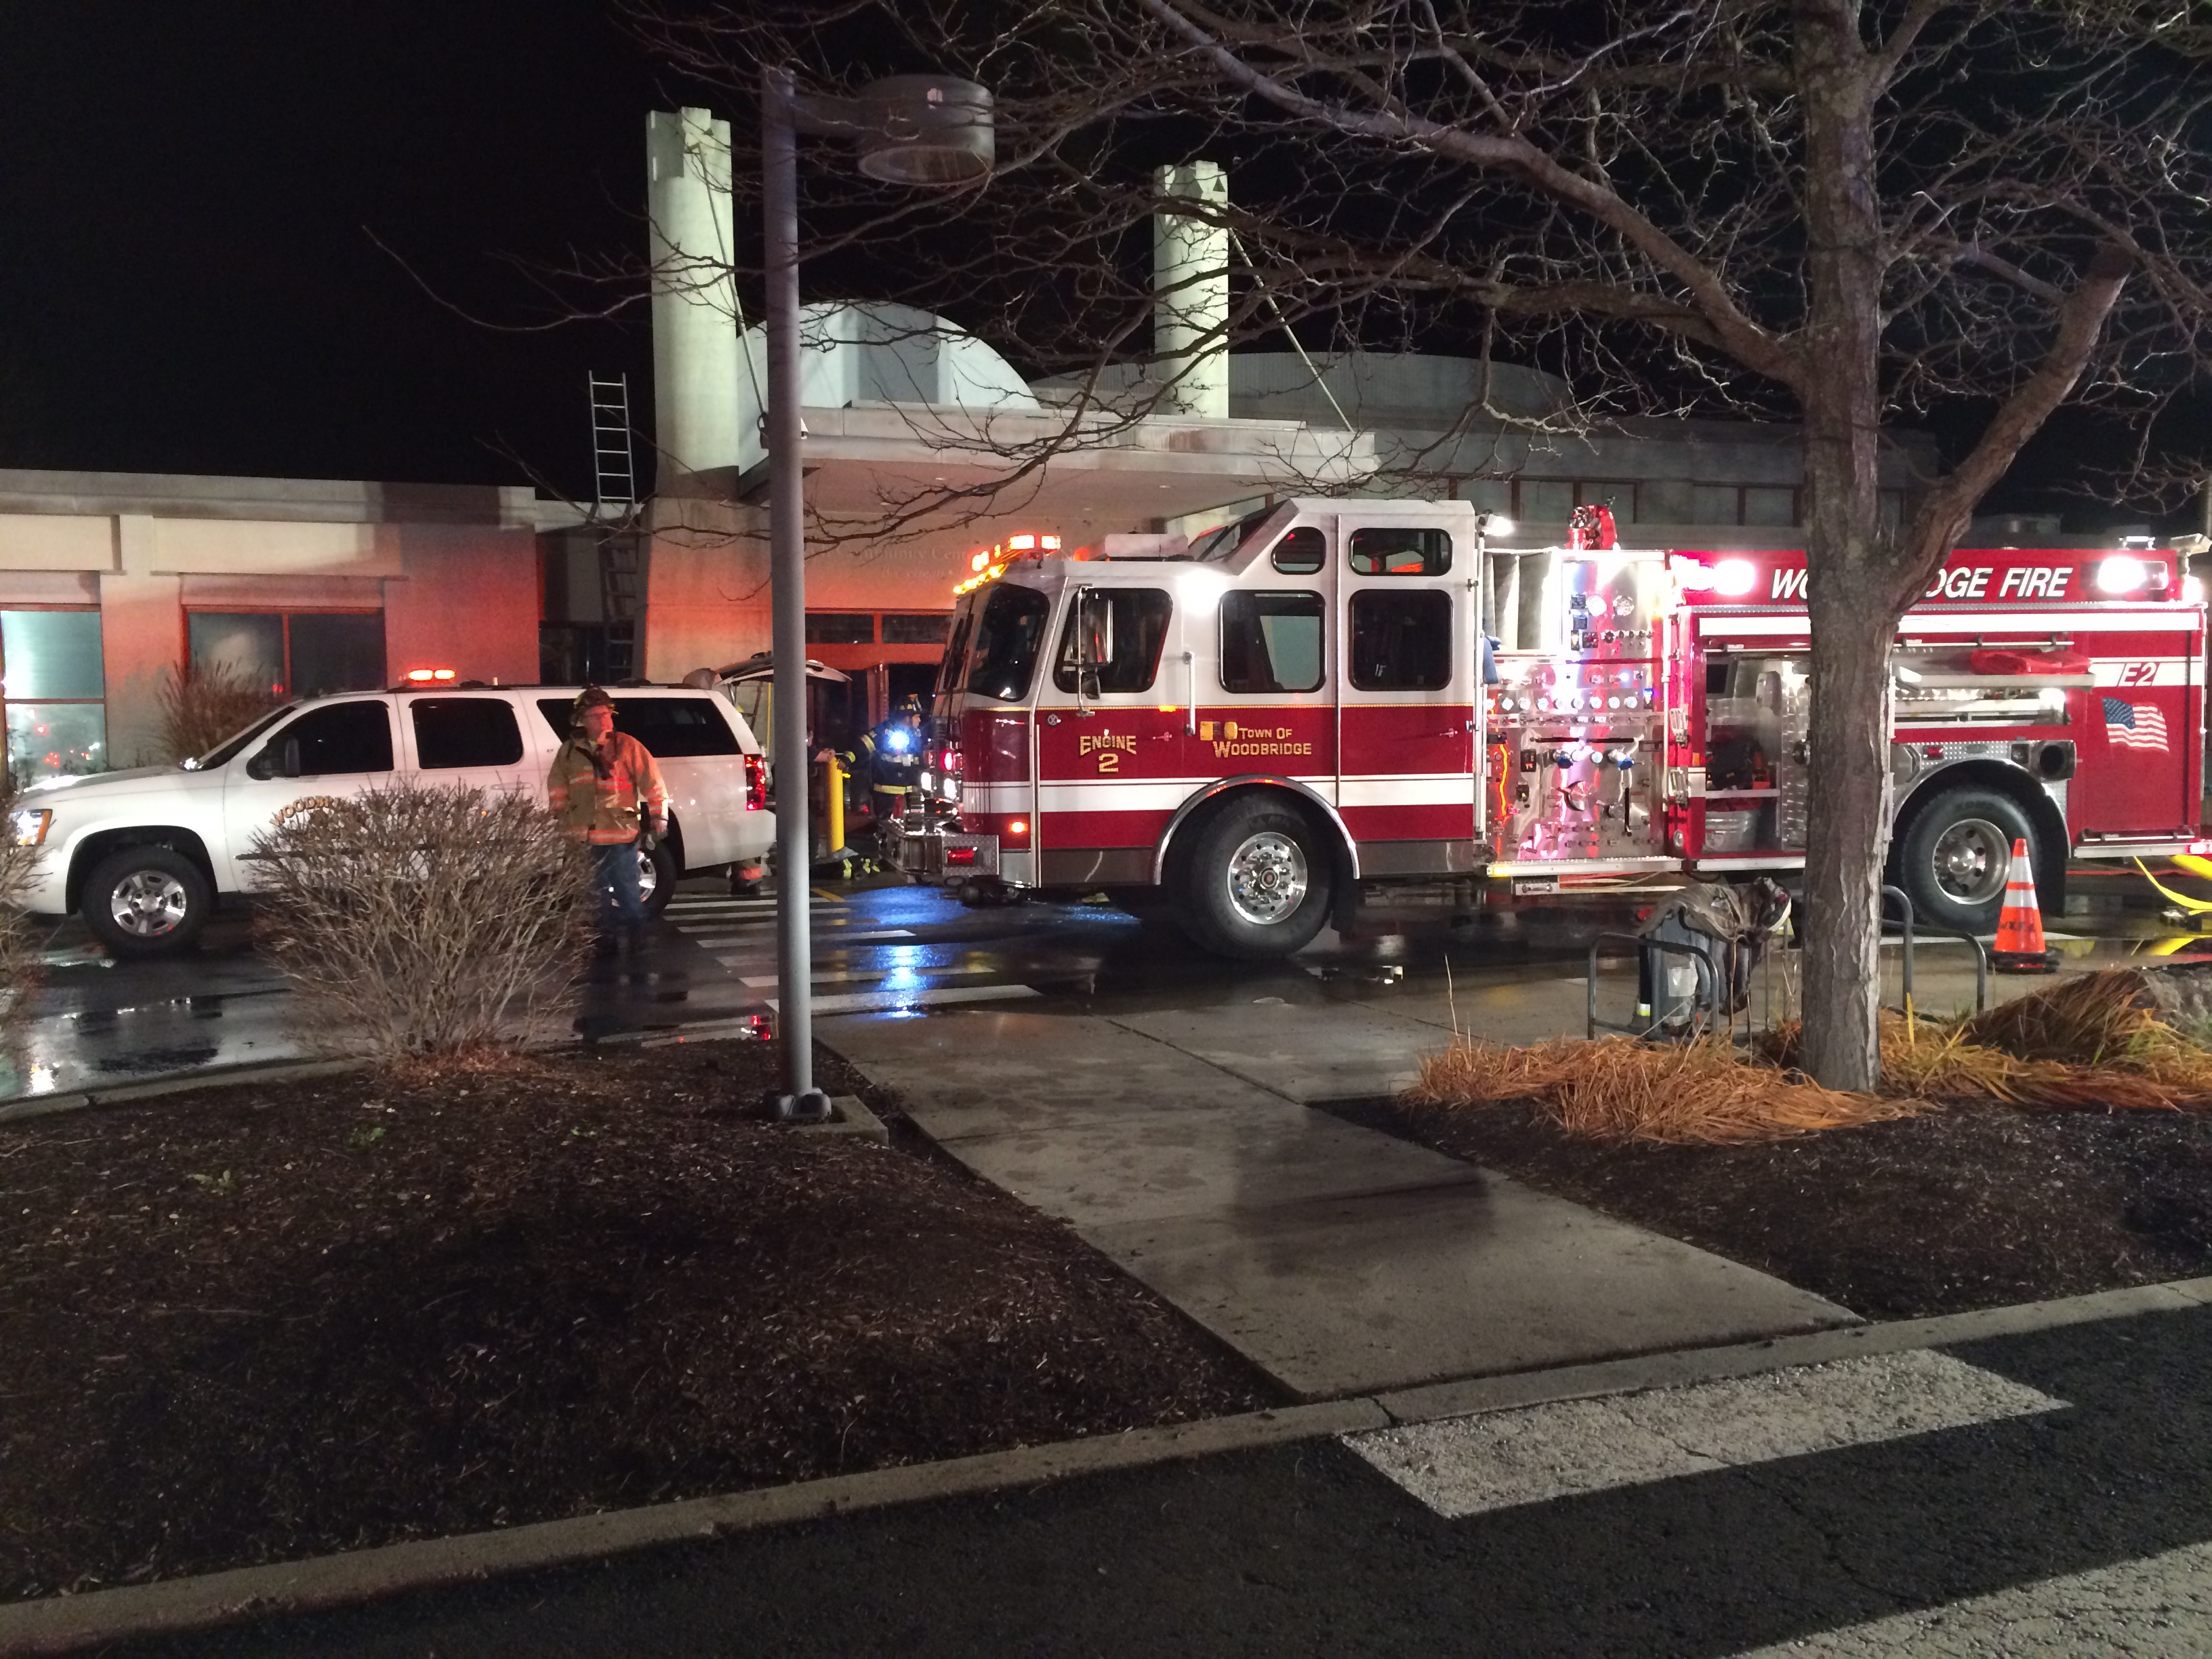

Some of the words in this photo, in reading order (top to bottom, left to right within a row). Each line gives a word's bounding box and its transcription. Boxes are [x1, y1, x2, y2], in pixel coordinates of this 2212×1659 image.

[931, 544, 969, 560] Cent
[1999, 567, 2074, 598] FIRE
[2118, 661, 2158, 687] E2
[1238, 727, 1272, 740] TOWN
[1275, 727, 1293, 739] OF
[1080, 735, 1137, 756] ENGINE
[1212, 740, 1312, 758] WOODBRIDGE
[1099, 753, 1119, 773] 2
